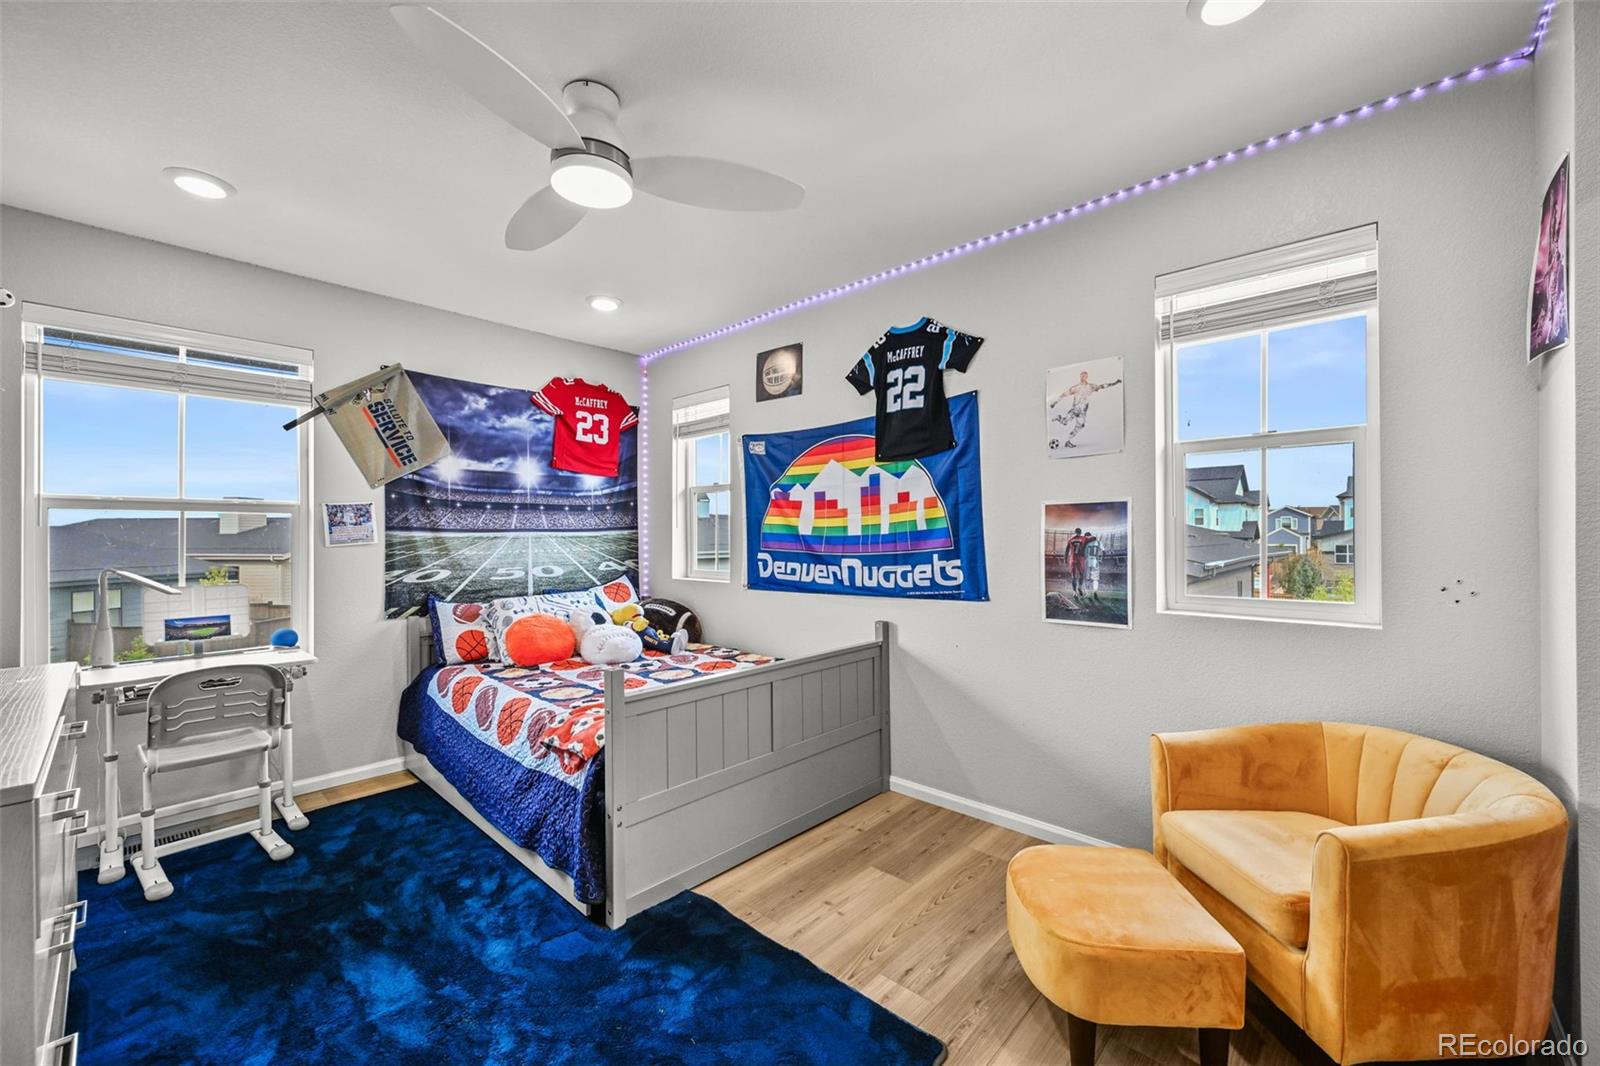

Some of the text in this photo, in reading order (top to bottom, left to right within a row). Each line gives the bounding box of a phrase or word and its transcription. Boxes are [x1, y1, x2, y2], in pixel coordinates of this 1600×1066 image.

[887, 345, 925, 363] McCAFFREY
[574, 396, 608, 410] McCAFFREY
[886, 365, 926, 413] 22
[367, 400, 418, 467] SERVICE
[383, 398, 415, 441] SALUTE TO
[575, 410, 610, 445] 23
[490, 565, 564, 580] 50
